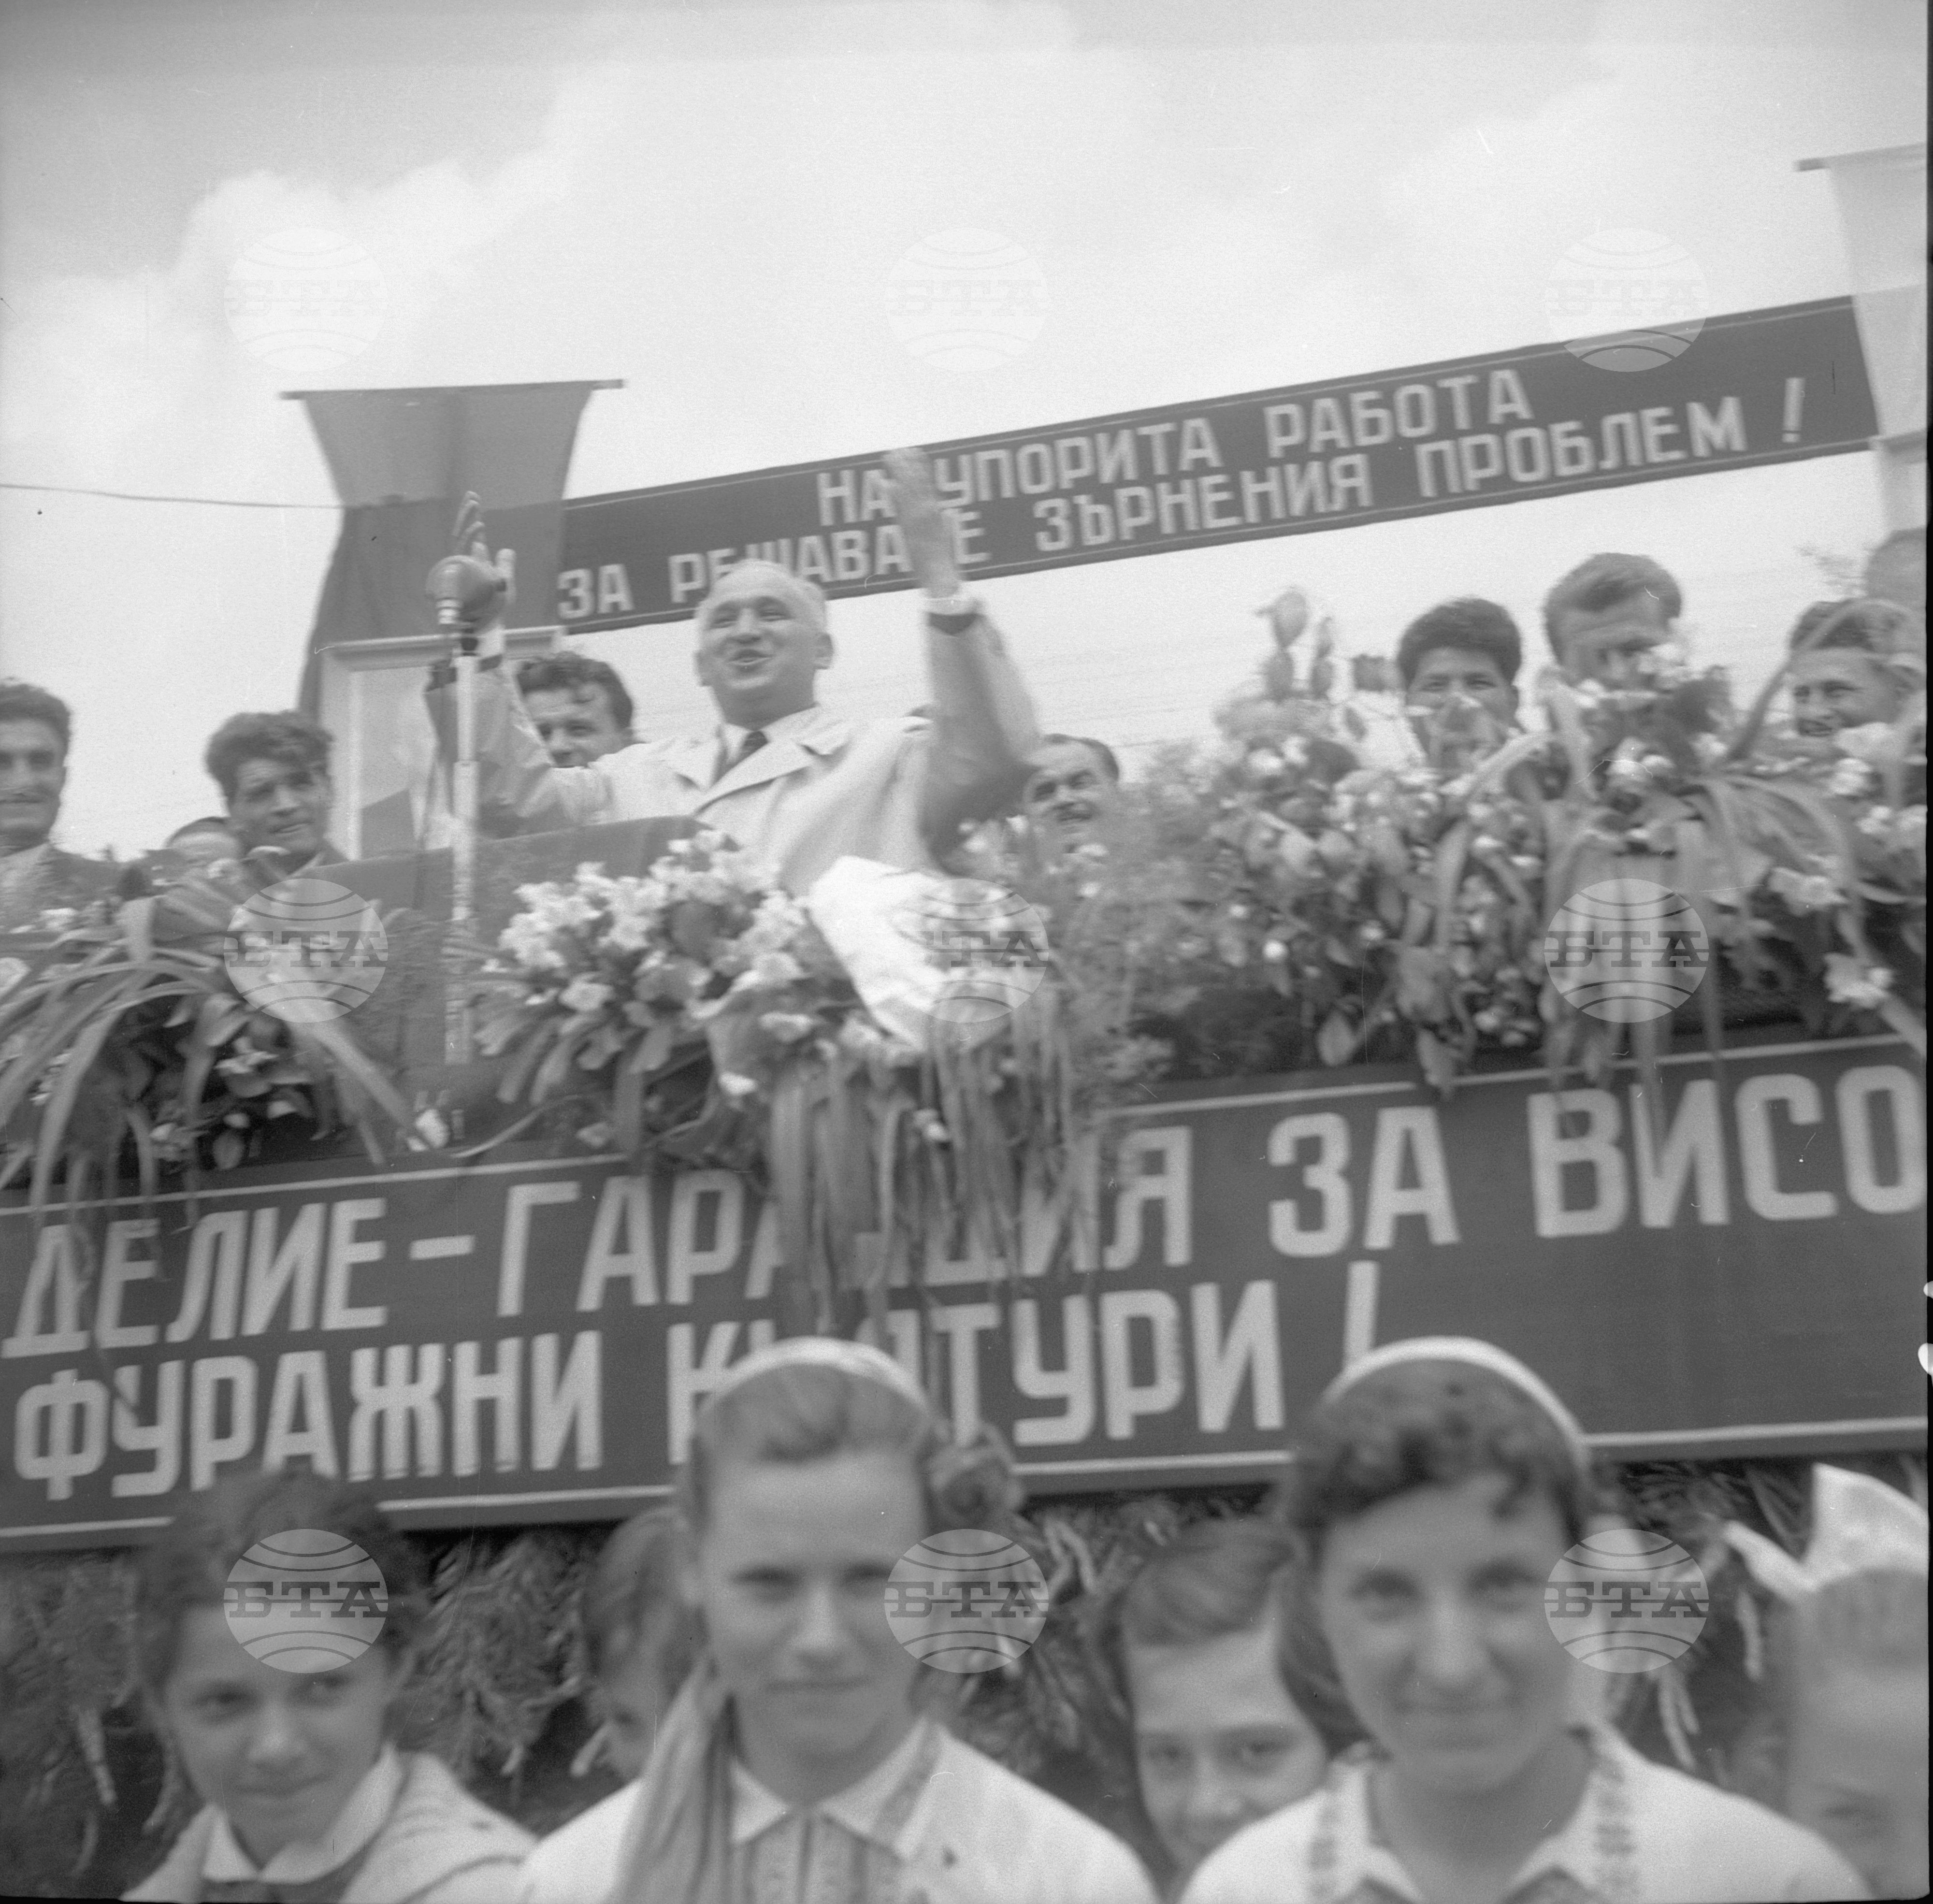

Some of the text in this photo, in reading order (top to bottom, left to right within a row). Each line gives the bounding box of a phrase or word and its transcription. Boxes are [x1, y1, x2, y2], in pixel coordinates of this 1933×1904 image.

[557, 377, 1806, 619] ЗА РЕАВАЕ ЗЪРНЕНИЯ ПРОБЛЕМ !
[817, 369, 1534, 526] НА УПОРИТА РАБОТА
[1, 1197, 388, 1358] ДЕЛИЕ
[497, 1125, 1193, 1317] ГАРИЯ
[1267, 1106, 1460, 1257] ЗА
[1527, 1065, 1927, 1239] ВИСО
[14, 1330, 603, 1501] ФУРАЖНИ
[666, 1280, 1285, 1465] КТУРИ
